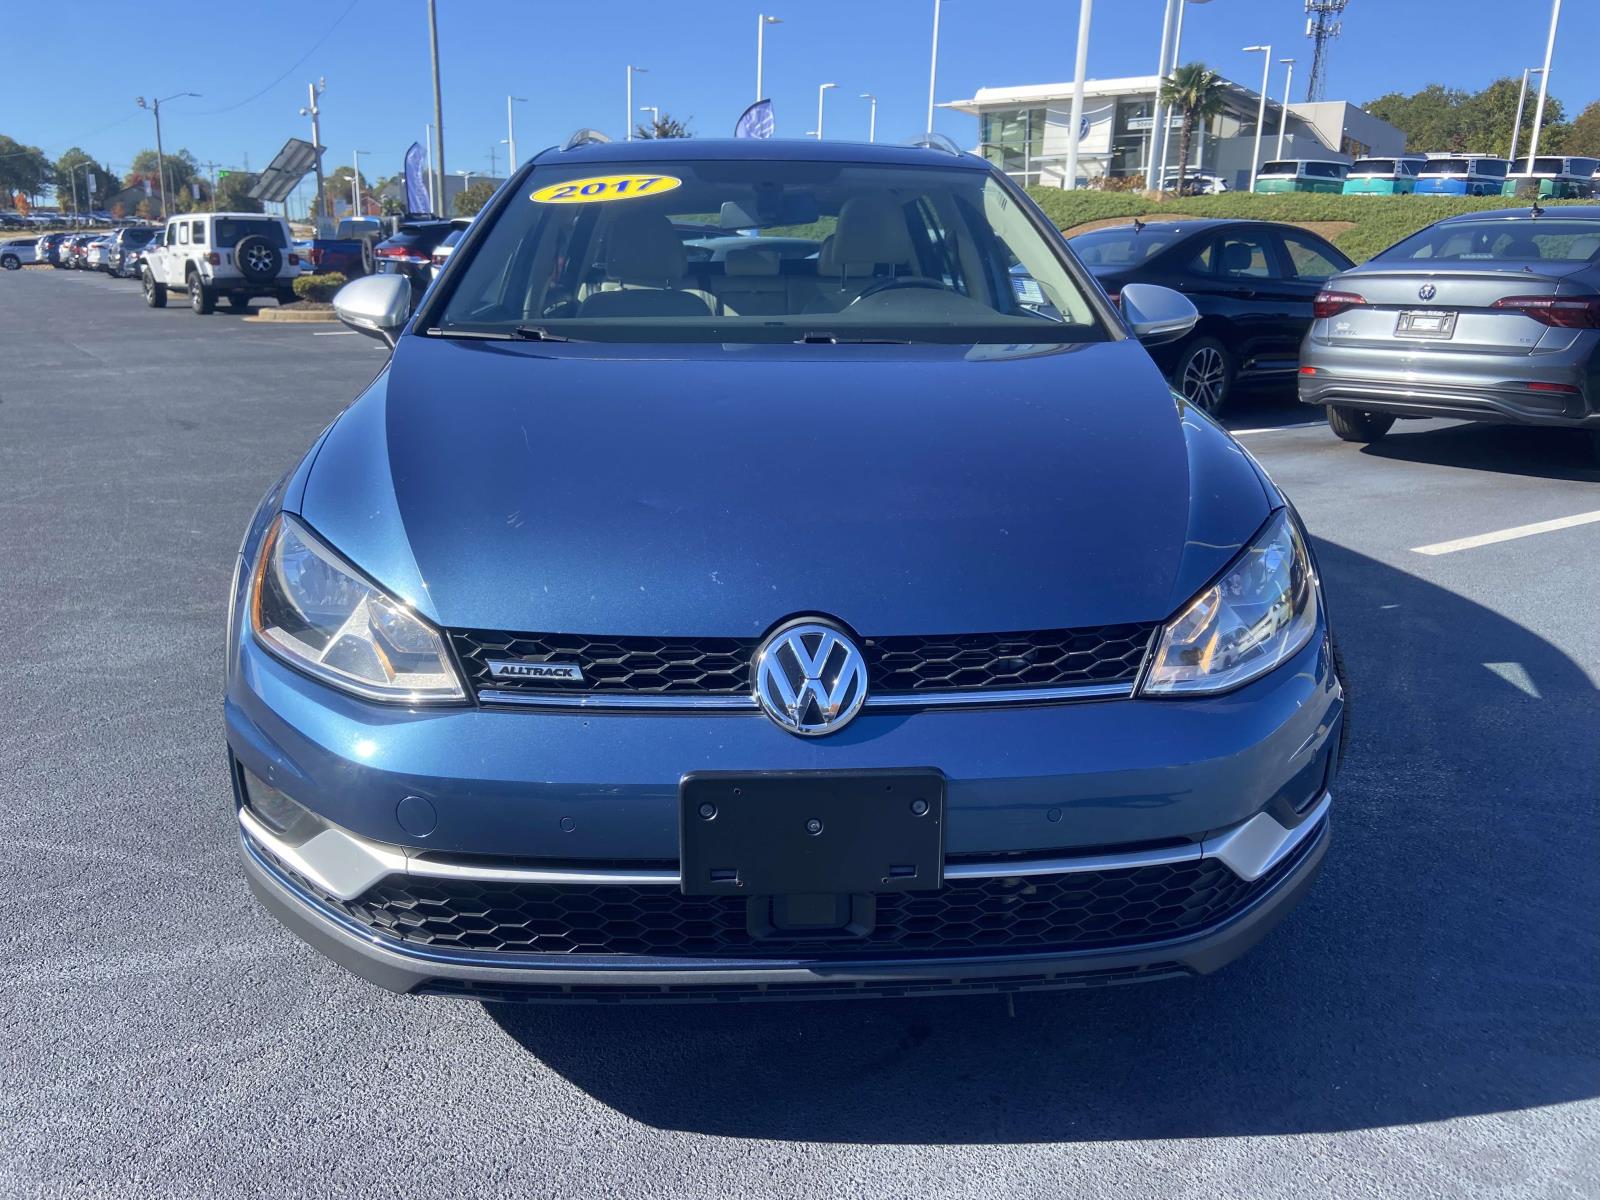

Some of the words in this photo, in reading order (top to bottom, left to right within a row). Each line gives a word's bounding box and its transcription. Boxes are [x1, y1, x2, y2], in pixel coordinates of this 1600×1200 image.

[549, 177, 662, 201] 2017
[499, 665, 574, 678] ALLTRACK
[757, 624, 868, 734] VW
